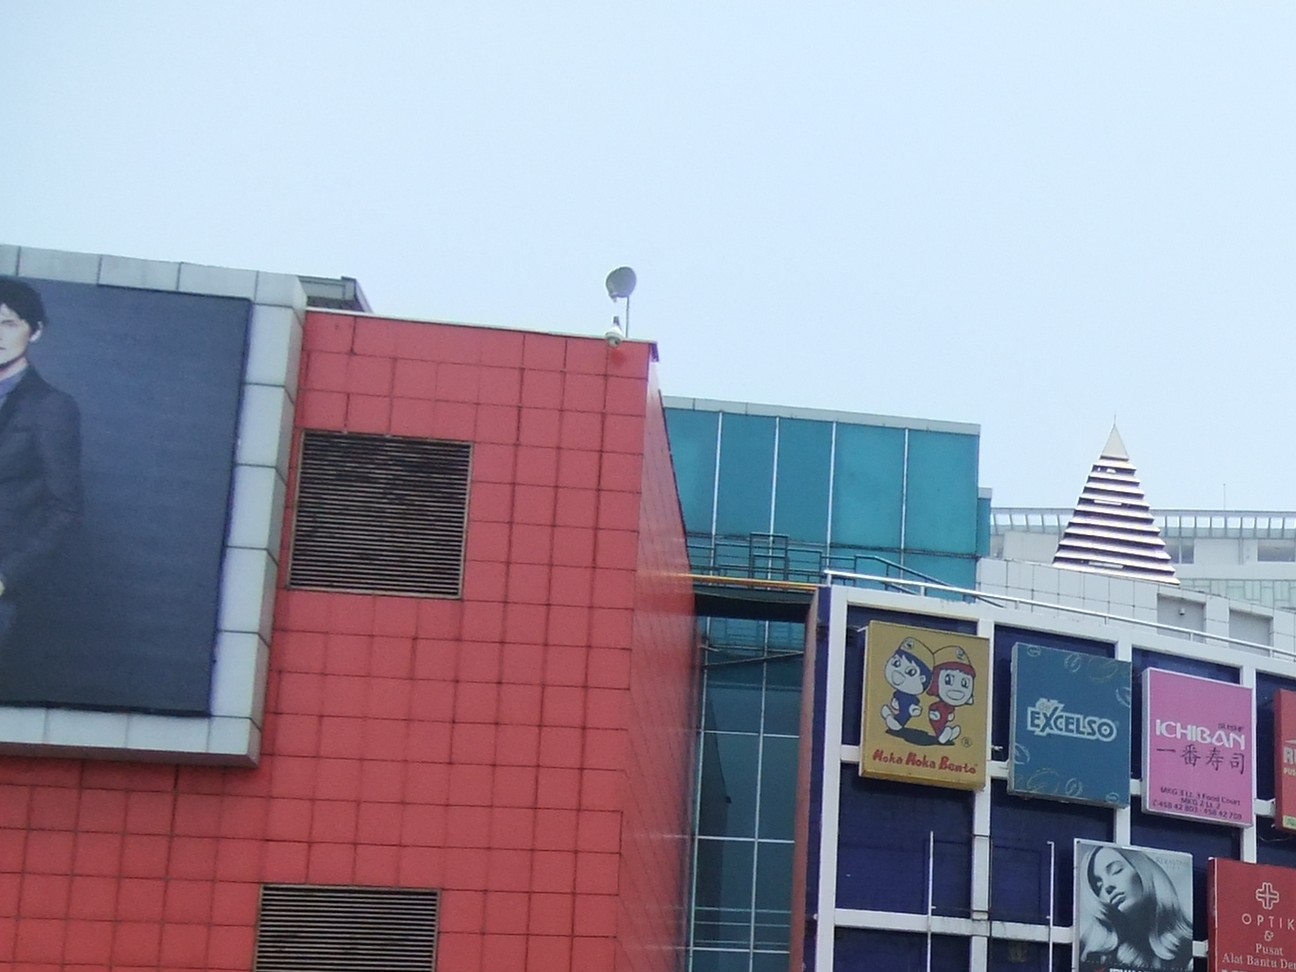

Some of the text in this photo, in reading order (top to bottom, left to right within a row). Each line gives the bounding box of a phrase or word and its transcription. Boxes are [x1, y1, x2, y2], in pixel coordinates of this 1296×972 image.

[1027, 702, 1117, 742] EXCELSO
[1156, 719, 1245, 750] ICHIBAN
[872, 749, 977, 775] Hoka Hoka Bento
[1156, 744, 1245, 775] 一番寿司
[1242, 913, 1295, 931] OPTIK
[1264, 930, 1274, 941] &
[1222, 952, 1243, 964] Alat
[1247, 955, 1277, 968] Bantu
[1255, 943, 1283, 956] Pusat
